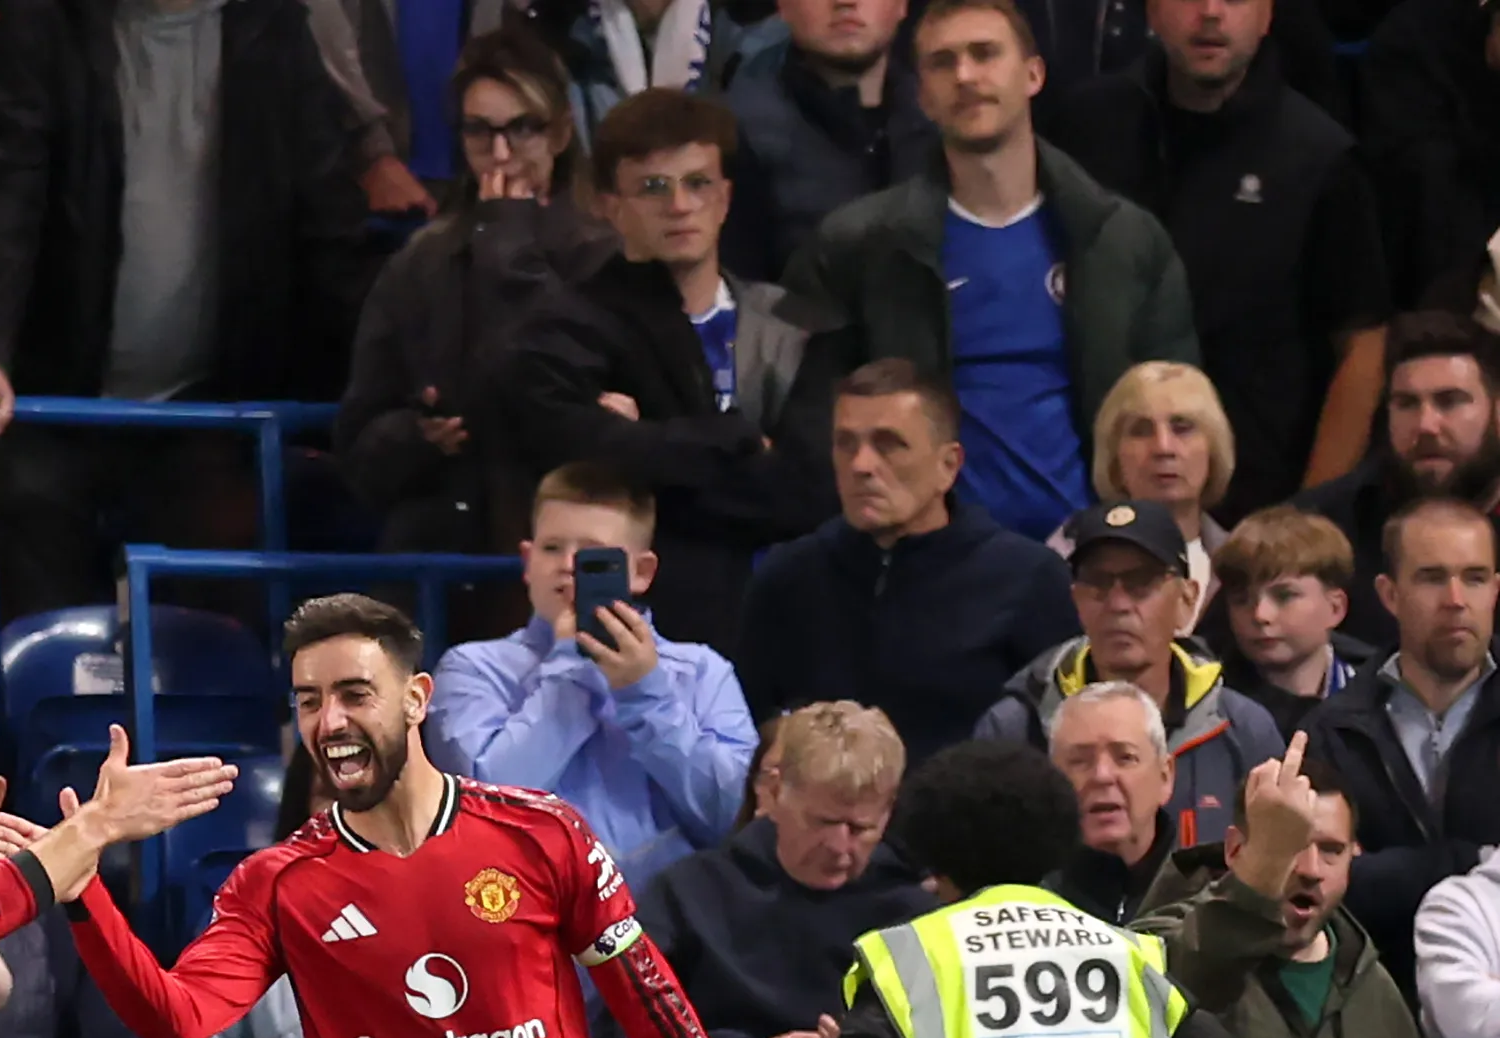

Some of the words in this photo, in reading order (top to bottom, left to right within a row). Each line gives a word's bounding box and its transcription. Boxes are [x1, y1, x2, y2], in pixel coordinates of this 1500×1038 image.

[974, 906, 1084, 926] SAFETY
[965, 928, 1112, 953] STEWARD
[975, 958, 1121, 1030] 599
